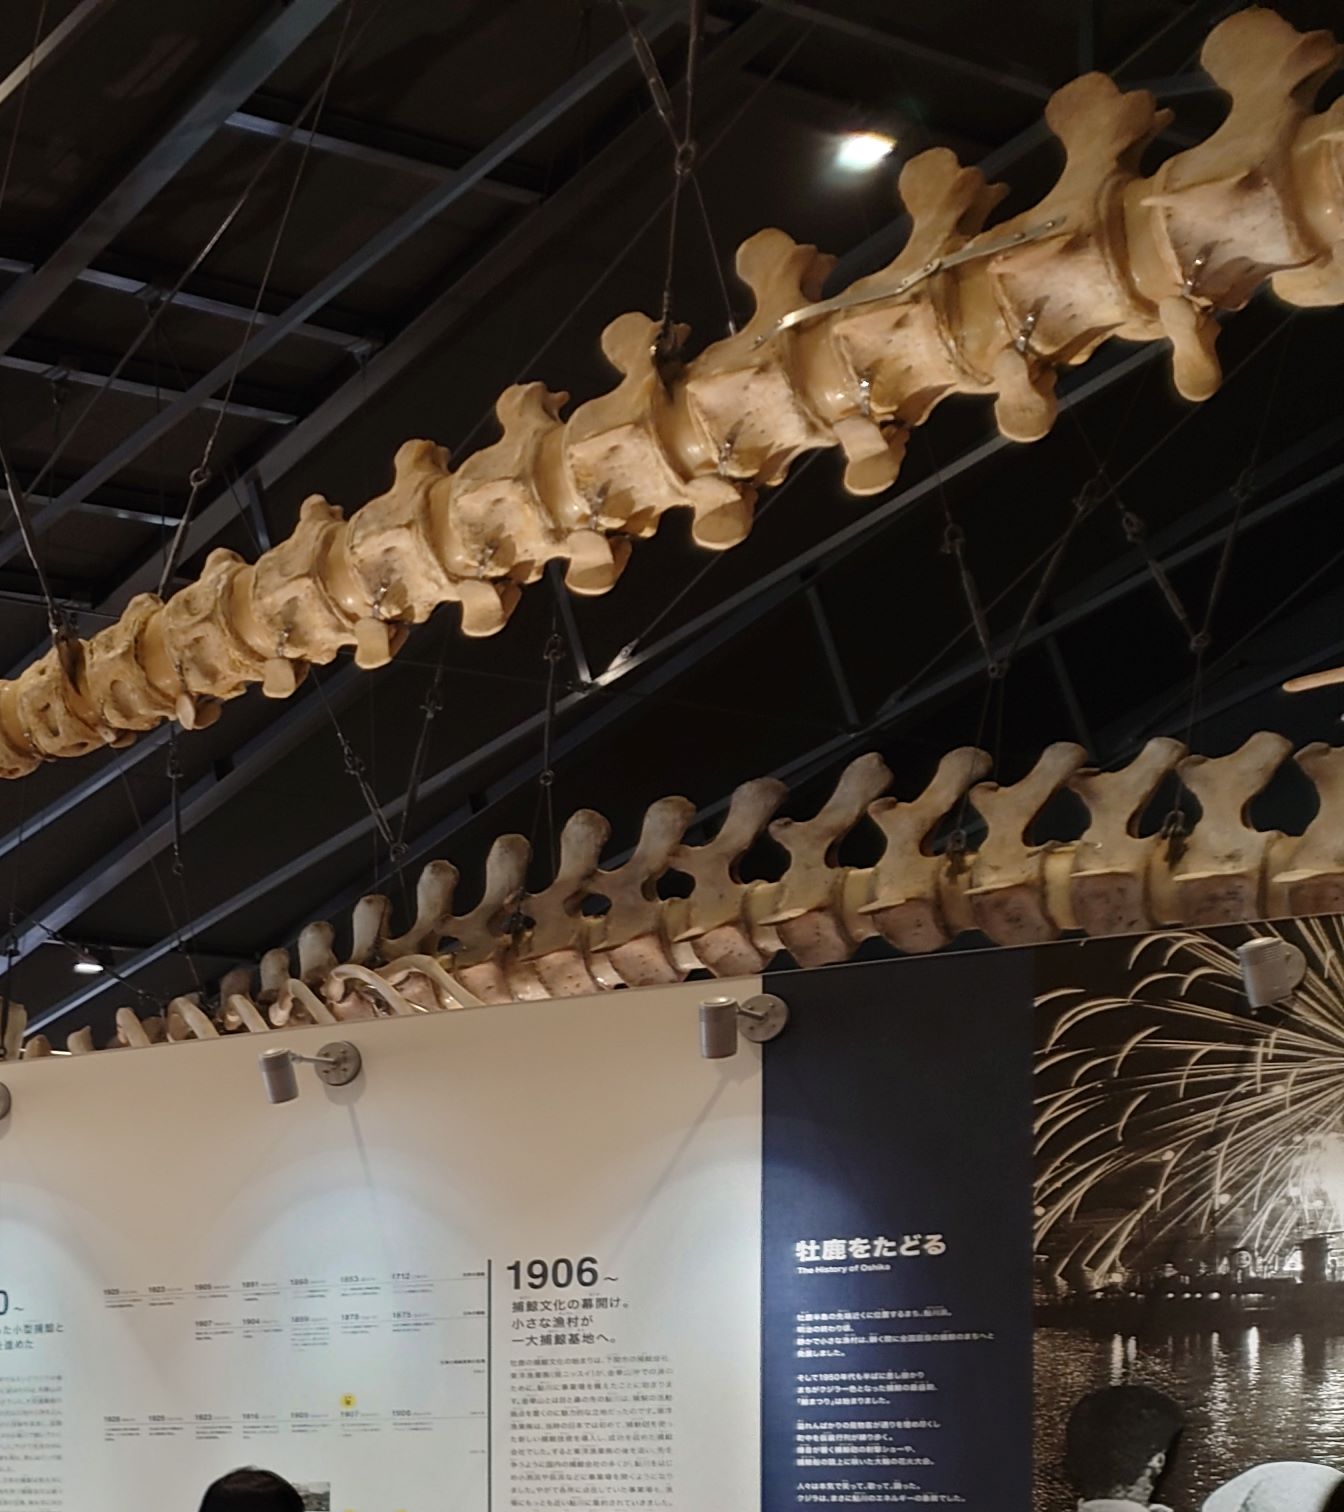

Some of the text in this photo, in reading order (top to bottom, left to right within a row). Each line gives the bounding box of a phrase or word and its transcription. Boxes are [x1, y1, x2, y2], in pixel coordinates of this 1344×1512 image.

[794, 1233, 947, 1262] 牡鹿をたどる
[511, 1297, 630, 1313] 捕鯨文化の幕開け。
[511, 1315, 594, 1330] 小さな漁村が
[511, 1332, 617, 1347] 一大捕鯨基地へ。
